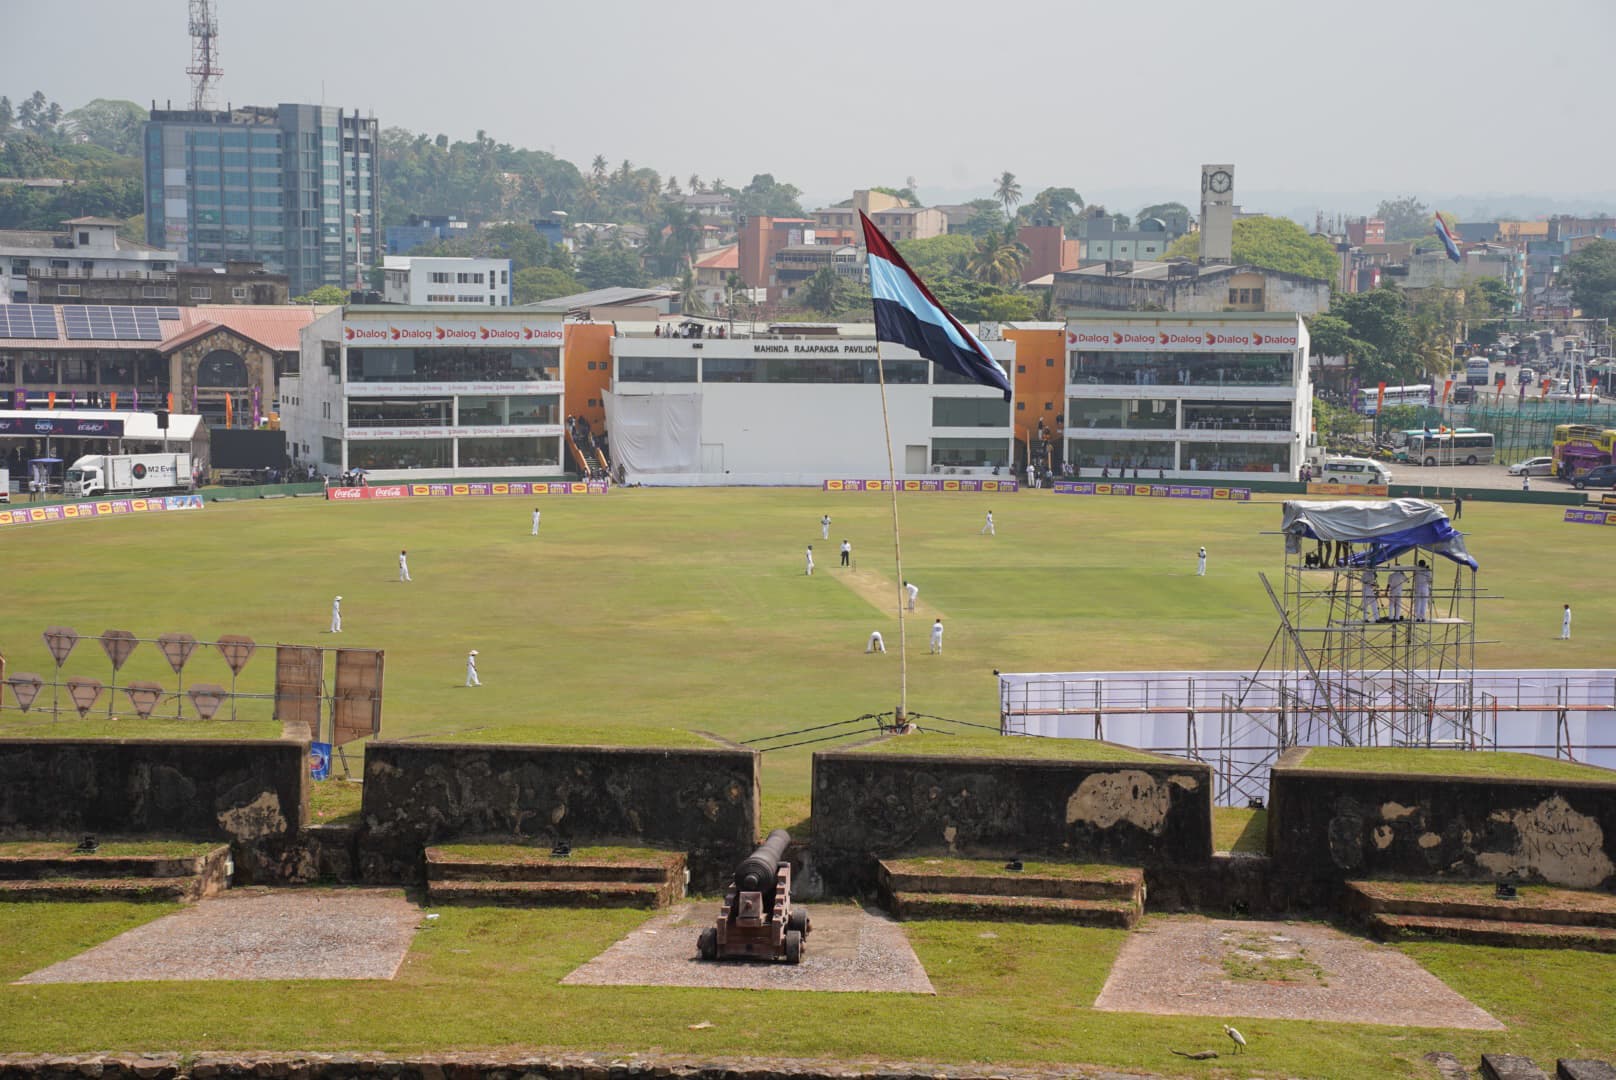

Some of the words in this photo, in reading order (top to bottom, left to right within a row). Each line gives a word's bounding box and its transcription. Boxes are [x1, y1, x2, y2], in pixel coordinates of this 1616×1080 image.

[356, 329, 387, 340] Dialog
[402, 329, 432, 340] Dialog
[446, 329, 476, 340] Dialog
[490, 329, 520, 340] Dialog
[534, 329, 563, 340] Dialog
[1078, 334, 1109, 345] Dialog
[1124, 334, 1155, 345] Dialog
[1170, 334, 1201, 345] Dialog
[1217, 334, 1249, 345] Dialog
[1264, 335, 1296, 346] Dialog
[753, 345, 789, 353] MAHINDA
[794, 345, 839, 353] RAJAPAKSA
[844, 345, 878, 353] PAVILION
